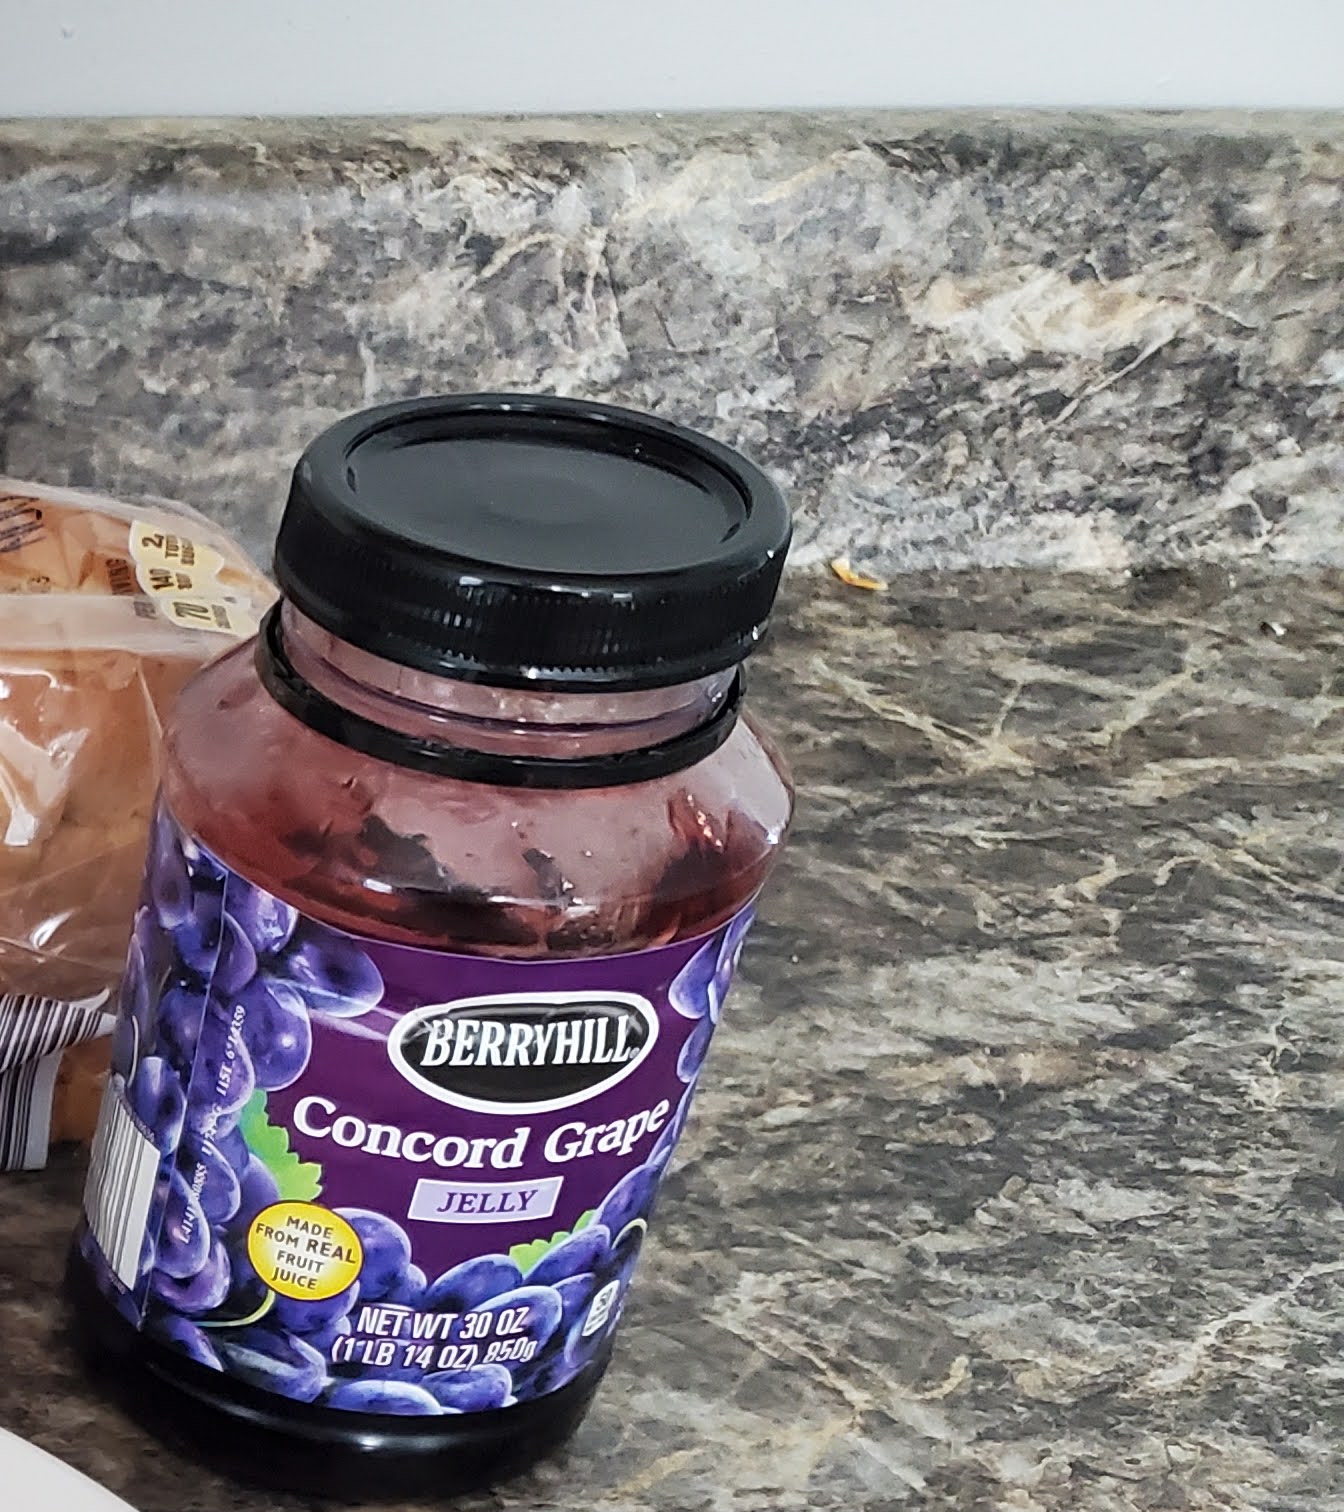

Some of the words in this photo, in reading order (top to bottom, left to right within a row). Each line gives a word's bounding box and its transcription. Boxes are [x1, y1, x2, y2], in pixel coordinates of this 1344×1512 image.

[420, 1015, 634, 1067] BERRYHILL
[292, 1095, 532, 1169] Concord
[543, 1099, 671, 1162] Grape
[436, 1188, 539, 1215] JELLY
[255, 1222, 301, 1249] FROM
[306, 1237, 357, 1264] REAL
[286, 1214, 335, 1240] MADE
[271, 1265, 318, 1291] JUICE
[276, 1250, 325, 1274] FRUIT
[356, 1305, 409, 1336] NET
[413, 1312, 461, 1340] WT
[463, 1312, 491, 1340] 30
[497, 1306, 531, 1335] OZ
[362, 1337, 394, 1367] LB
[441, 1343, 481, 1371] OZ)
[483, 1336, 538, 1366] 850g
